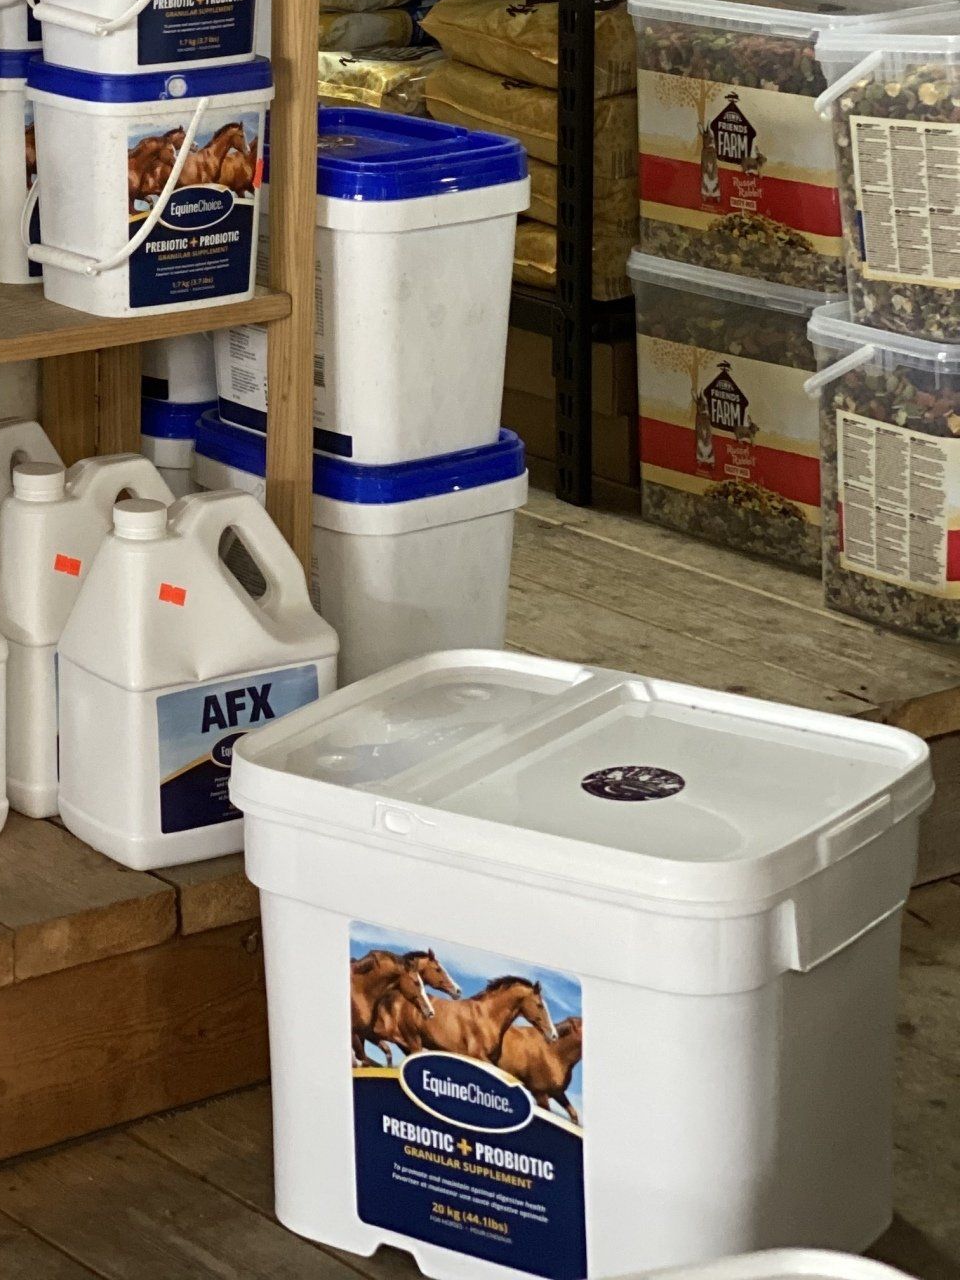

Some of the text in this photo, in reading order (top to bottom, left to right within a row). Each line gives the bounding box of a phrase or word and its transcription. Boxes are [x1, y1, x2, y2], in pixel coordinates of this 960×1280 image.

[718, 121, 748, 134] FRIENDS
[718, 131, 748, 159] FARM
[146, 238, 188, 254] PREBIOTIC
[199, 230, 240, 246] PROBIOTIC
[711, 400, 741, 427] FARM
[200, 683, 276, 734] AFX
[422, 1070, 514, 1114] EquineChoice
[382, 1114, 555, 1180] PREBIOTIC + PROBIOTIC
[404, 1145, 533, 1190] GRANULAR SUPPLEMENT
[394, 1162, 401, 1171] To
[401, 1165, 428, 1180] promote
[428, 1170, 440, 1182] and
[442, 1174, 470, 1191] maintain
[496, 1190, 524, 1207] digestive
[524, 1200, 546, 1213] health
[432, 1202, 445, 1214] 20
[447, 1205, 461, 1221] kg
